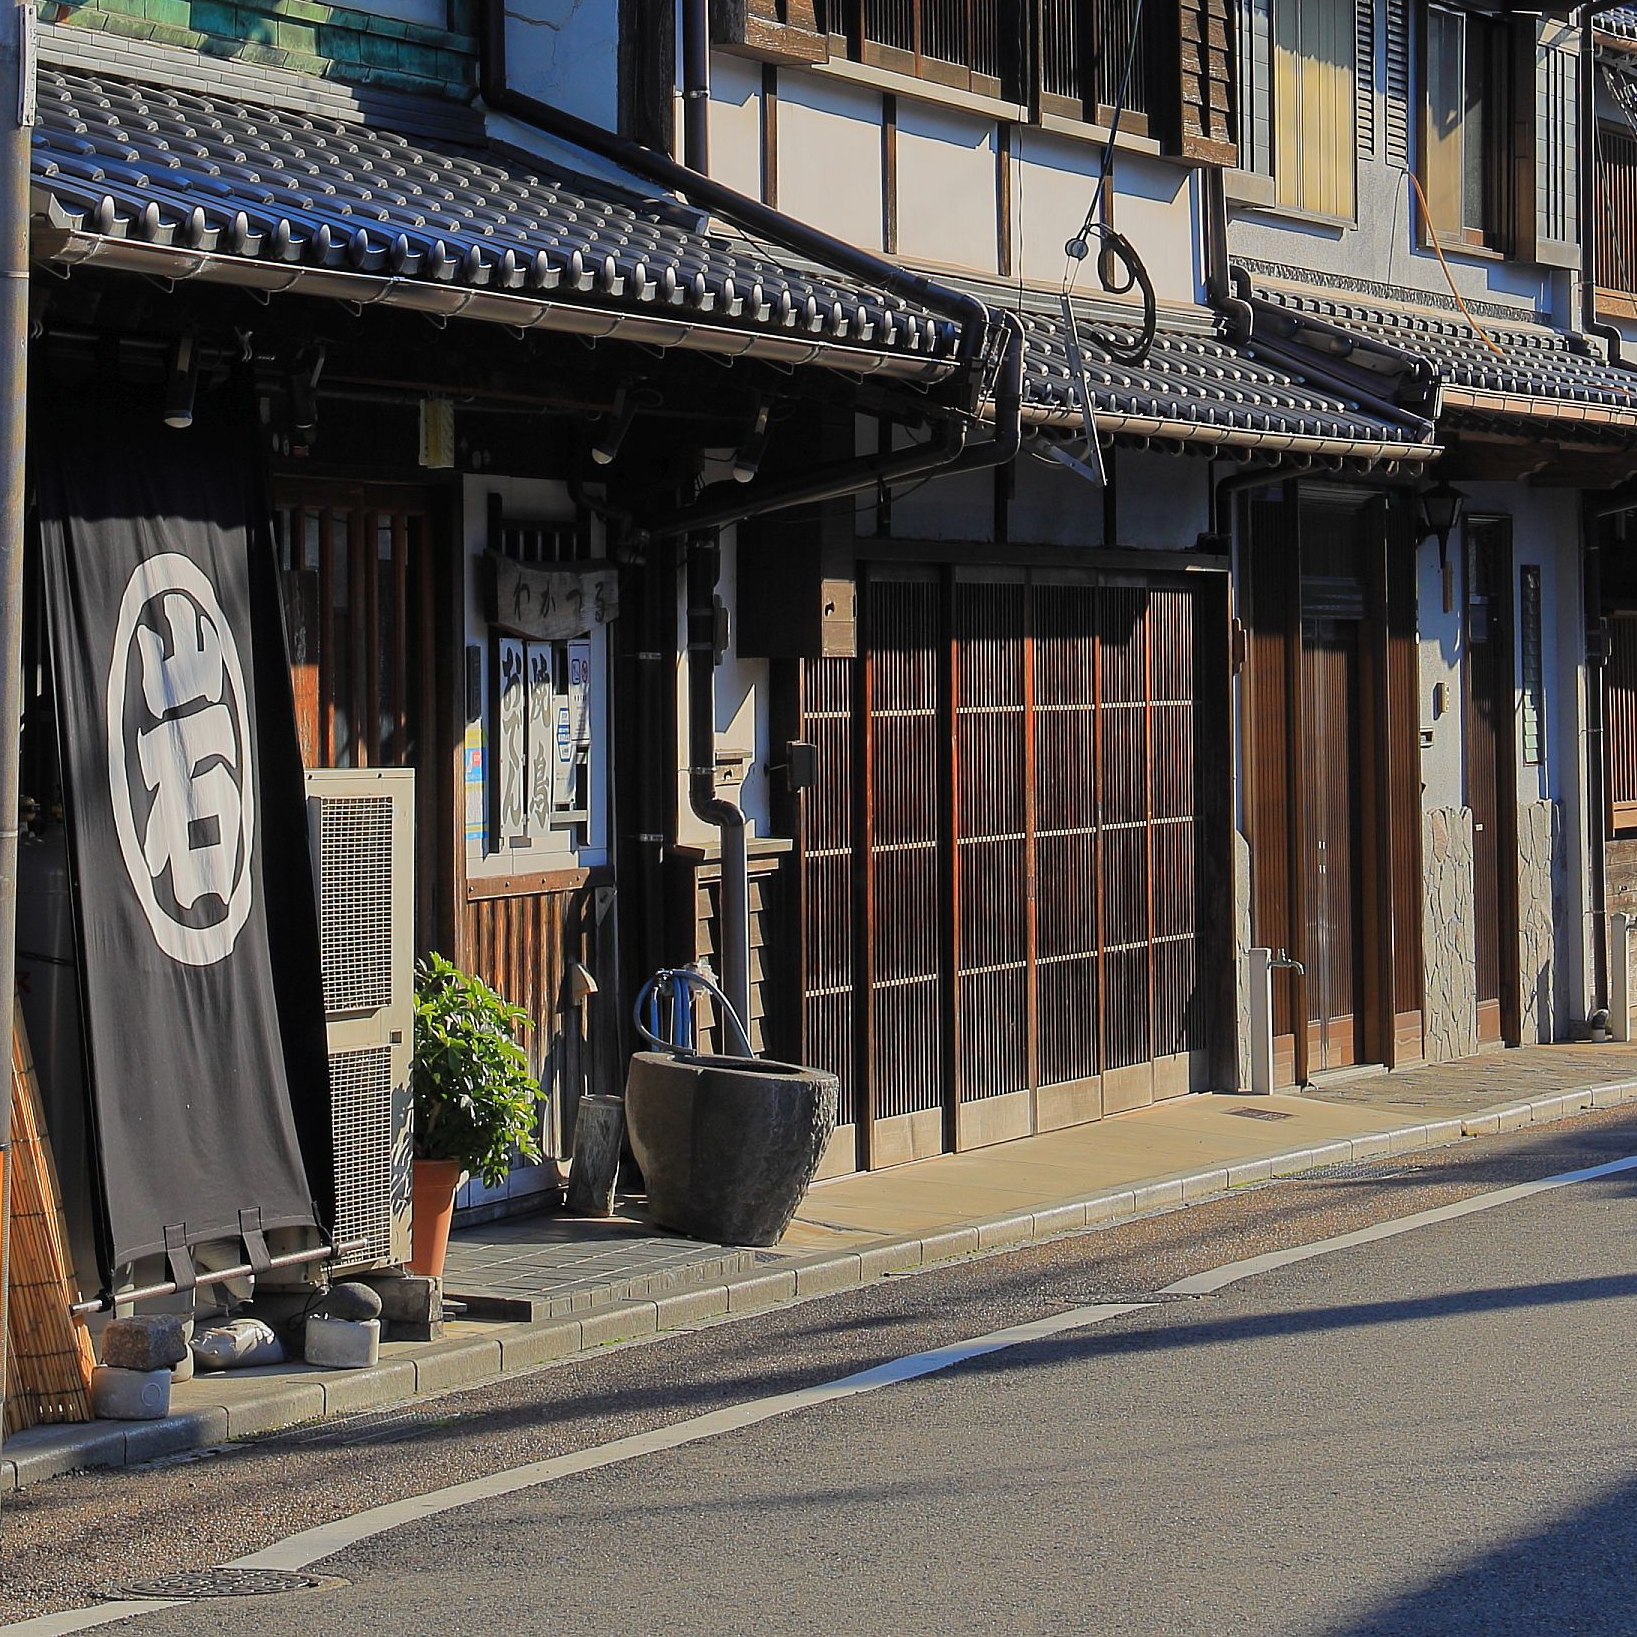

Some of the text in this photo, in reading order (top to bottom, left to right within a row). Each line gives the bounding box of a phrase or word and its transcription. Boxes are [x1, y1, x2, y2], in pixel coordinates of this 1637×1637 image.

[513, 572, 607, 625] わかつる
[502, 646, 522, 829] おでん
